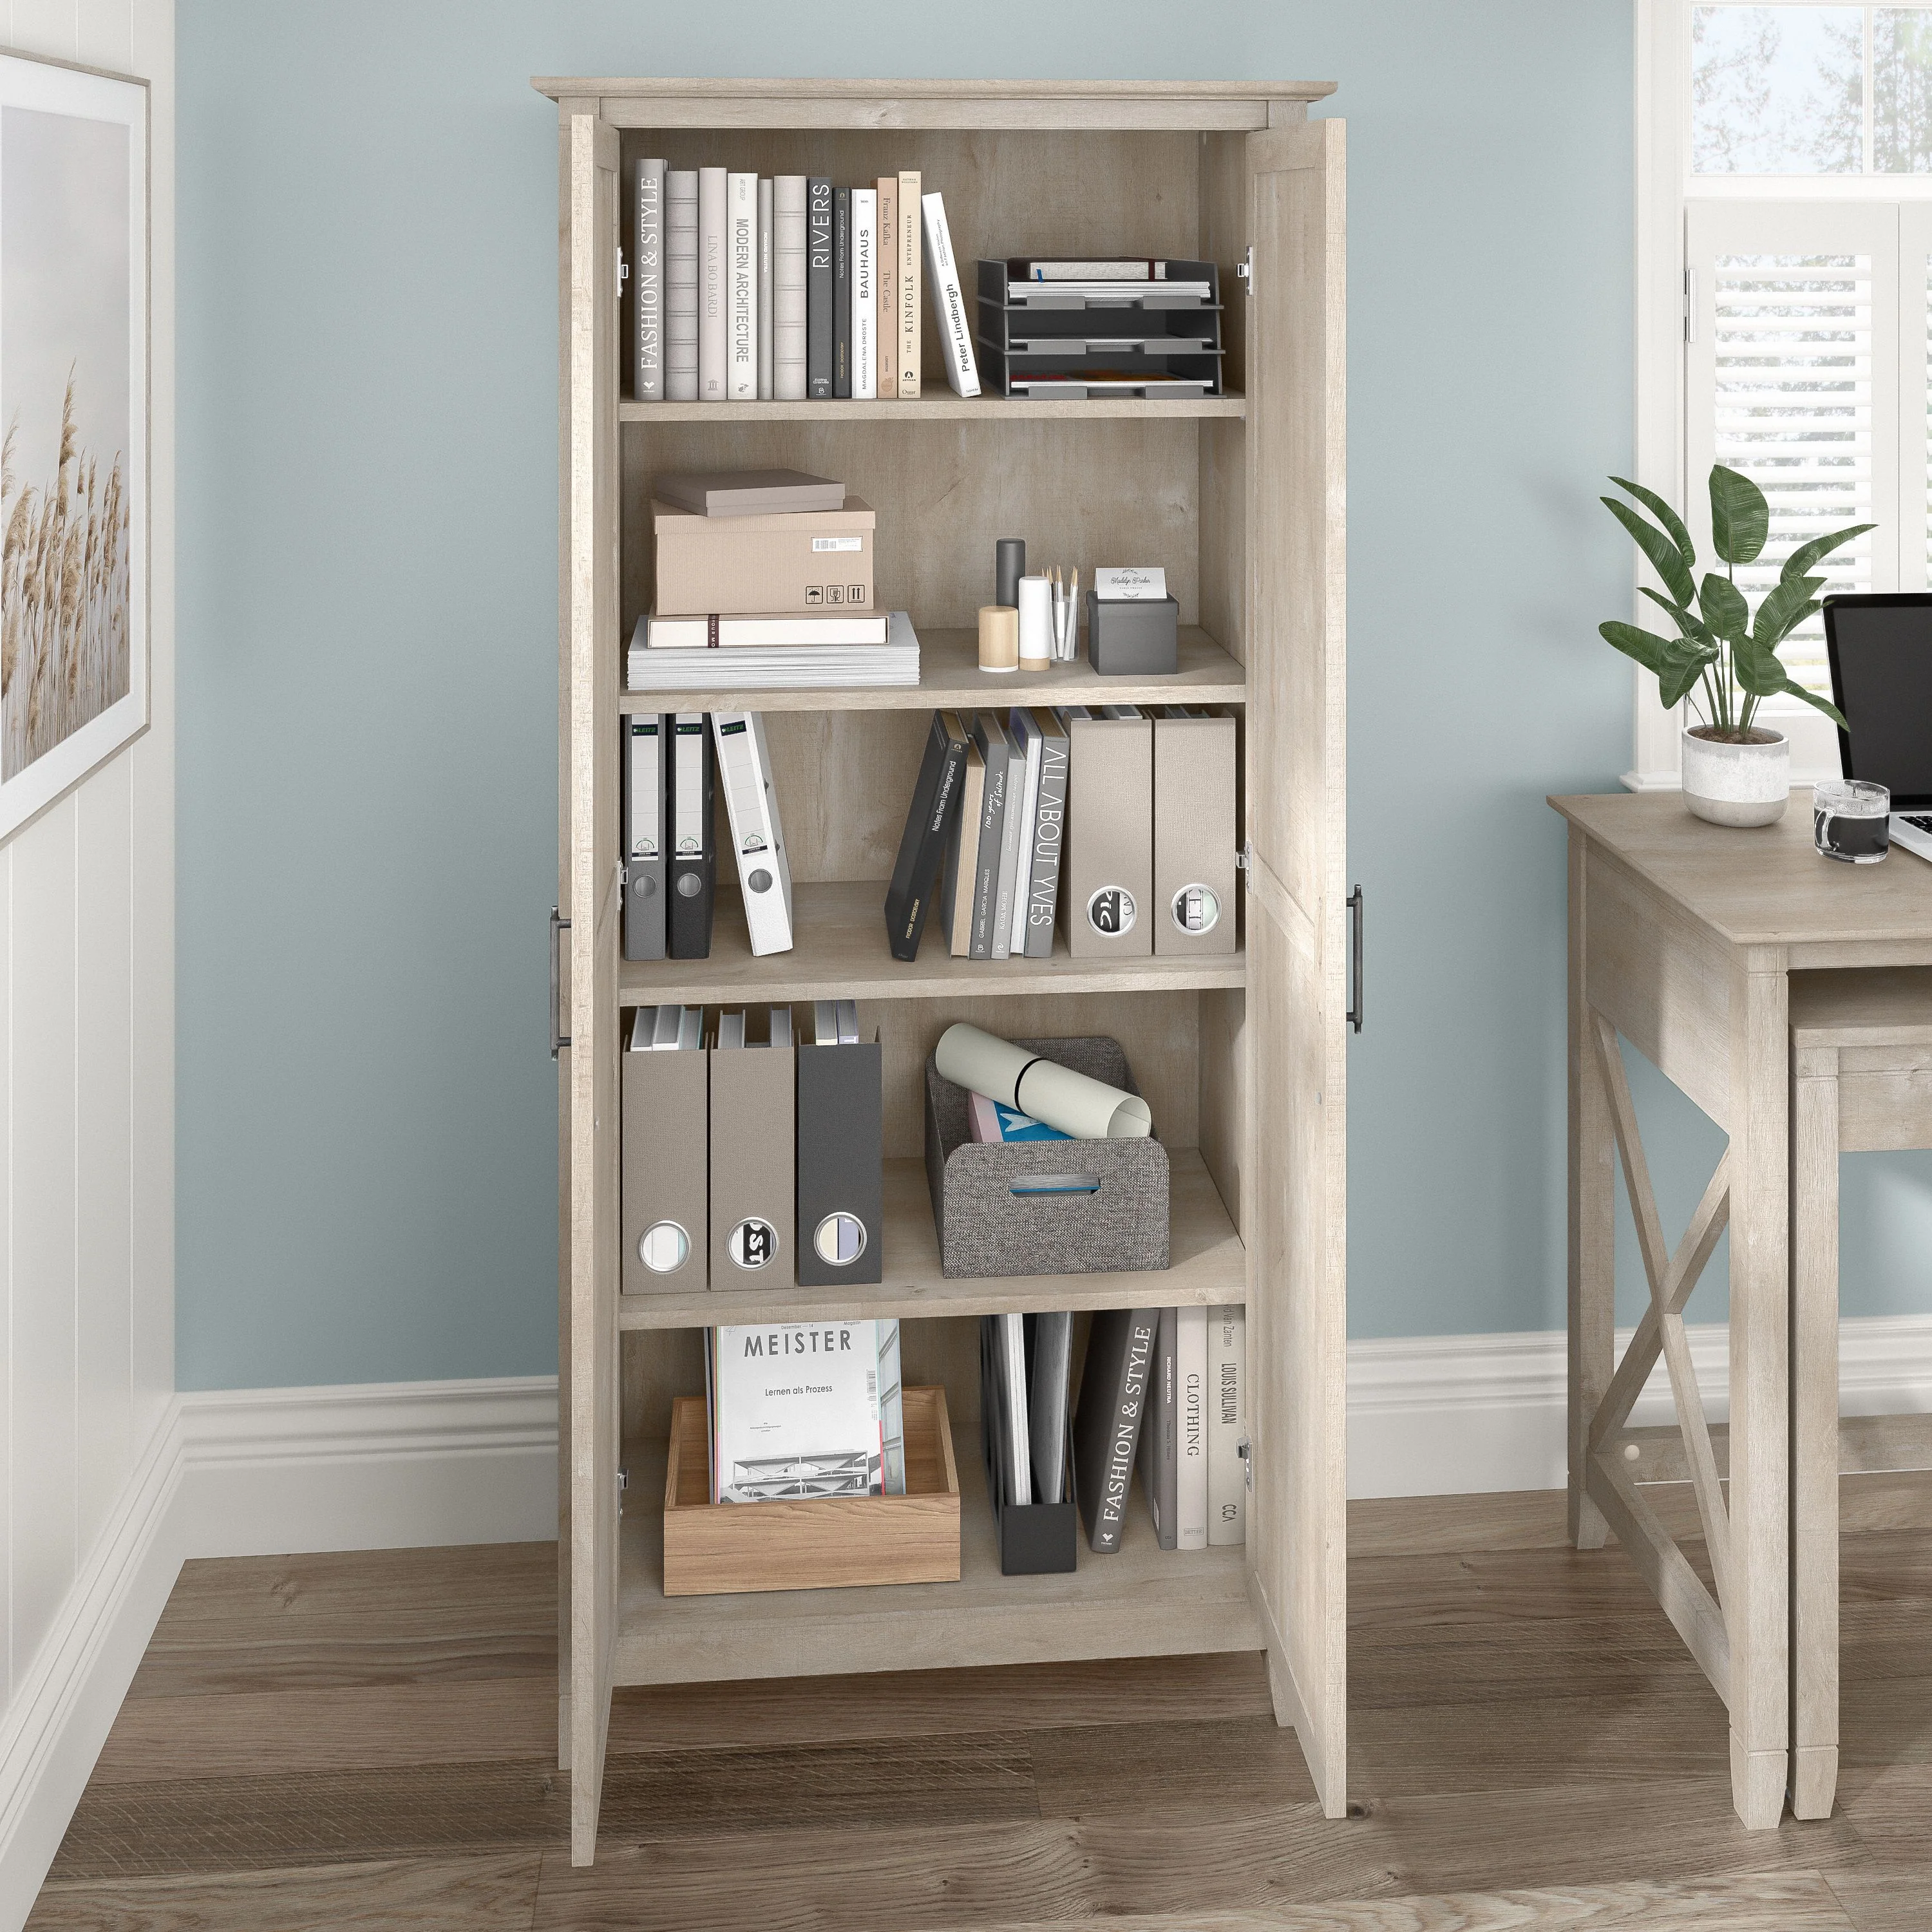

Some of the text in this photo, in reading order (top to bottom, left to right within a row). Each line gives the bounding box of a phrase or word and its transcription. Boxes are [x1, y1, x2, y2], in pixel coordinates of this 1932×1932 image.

[812, 184, 829, 268] RIVERS
[641, 178, 658, 369] FASHION & STYLE
[708, 236, 718, 317] LINA BO BARDI
[736, 218, 749, 363] MODERN ARCHITECTURE
[860, 229, 869, 298] BAUHAUS
[905, 275, 913, 333] KINFOLK
[946, 283, 970, 373] Peter Lindbergh
[1132, 576, 1151, 584] Parker
[994, 771, 1003, 807] of Solitude
[1042, 746, 1066, 785] ALL
[931, 761, 956, 831] Notes From Underground
[1036, 791, 1063, 866] ABOUT
[910, 898, 920, 922] DOSTOEVSKY
[1030, 875, 1056, 926] YVES
[744, 1330, 851, 1357] MEISTER
[1224, 1314, 1235, 1325] Van
[1224, 1325, 1235, 1347] Zanten
[765, 1385, 833, 1396] Lernen als Prozess
[1125, 1327, 1151, 1396] STYLE
[1122, 1401, 1139, 1417] &
[1187, 1374, 1200, 1457] CLOTHING
[1221, 1363, 1237, 1424] LOUIS SULLIVAN
[1103, 1423, 1134, 1522] FASHION
[1222, 1504, 1237, 1522] CCA
